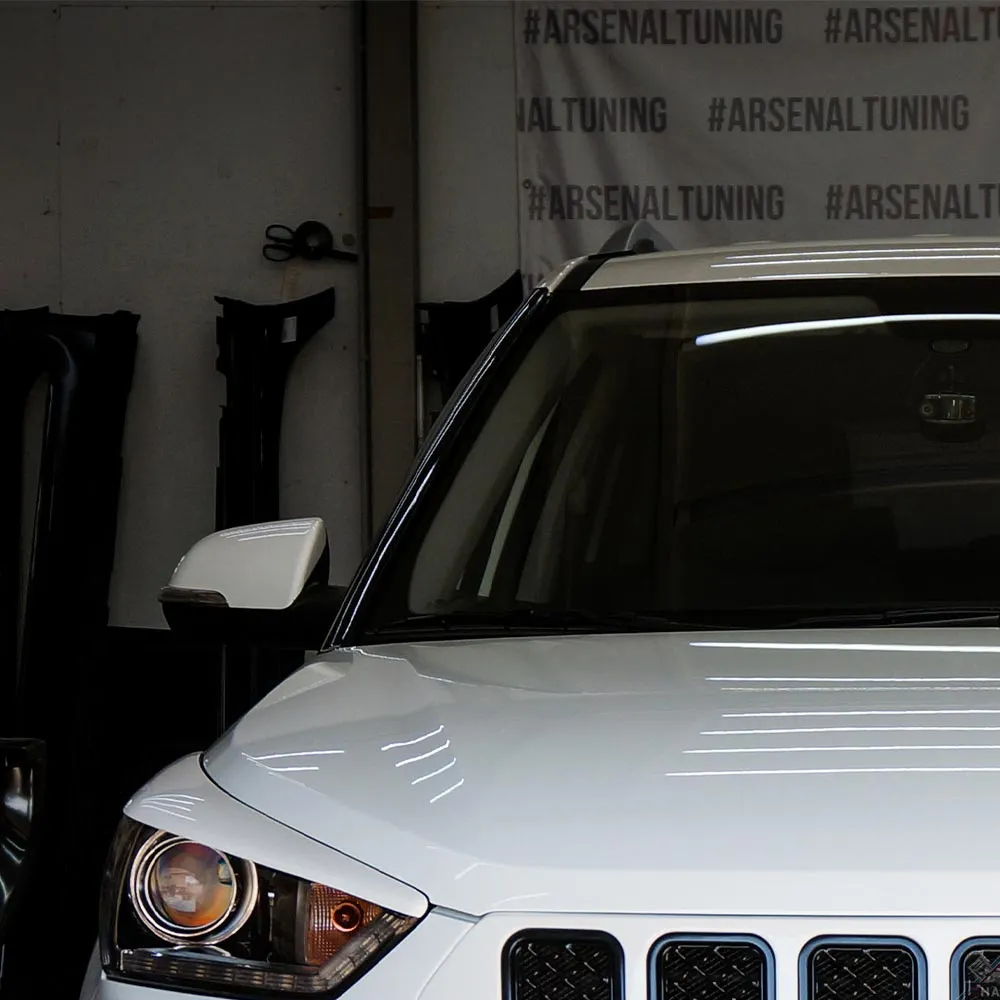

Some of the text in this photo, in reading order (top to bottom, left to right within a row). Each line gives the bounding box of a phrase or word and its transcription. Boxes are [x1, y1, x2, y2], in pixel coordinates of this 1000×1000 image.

[524, 8, 783, 45] #ARSENALTUNING
[708, 95, 970, 132] #ARSENALTUNING
[528, 185, 784, 221] #ARSENALTUNING
